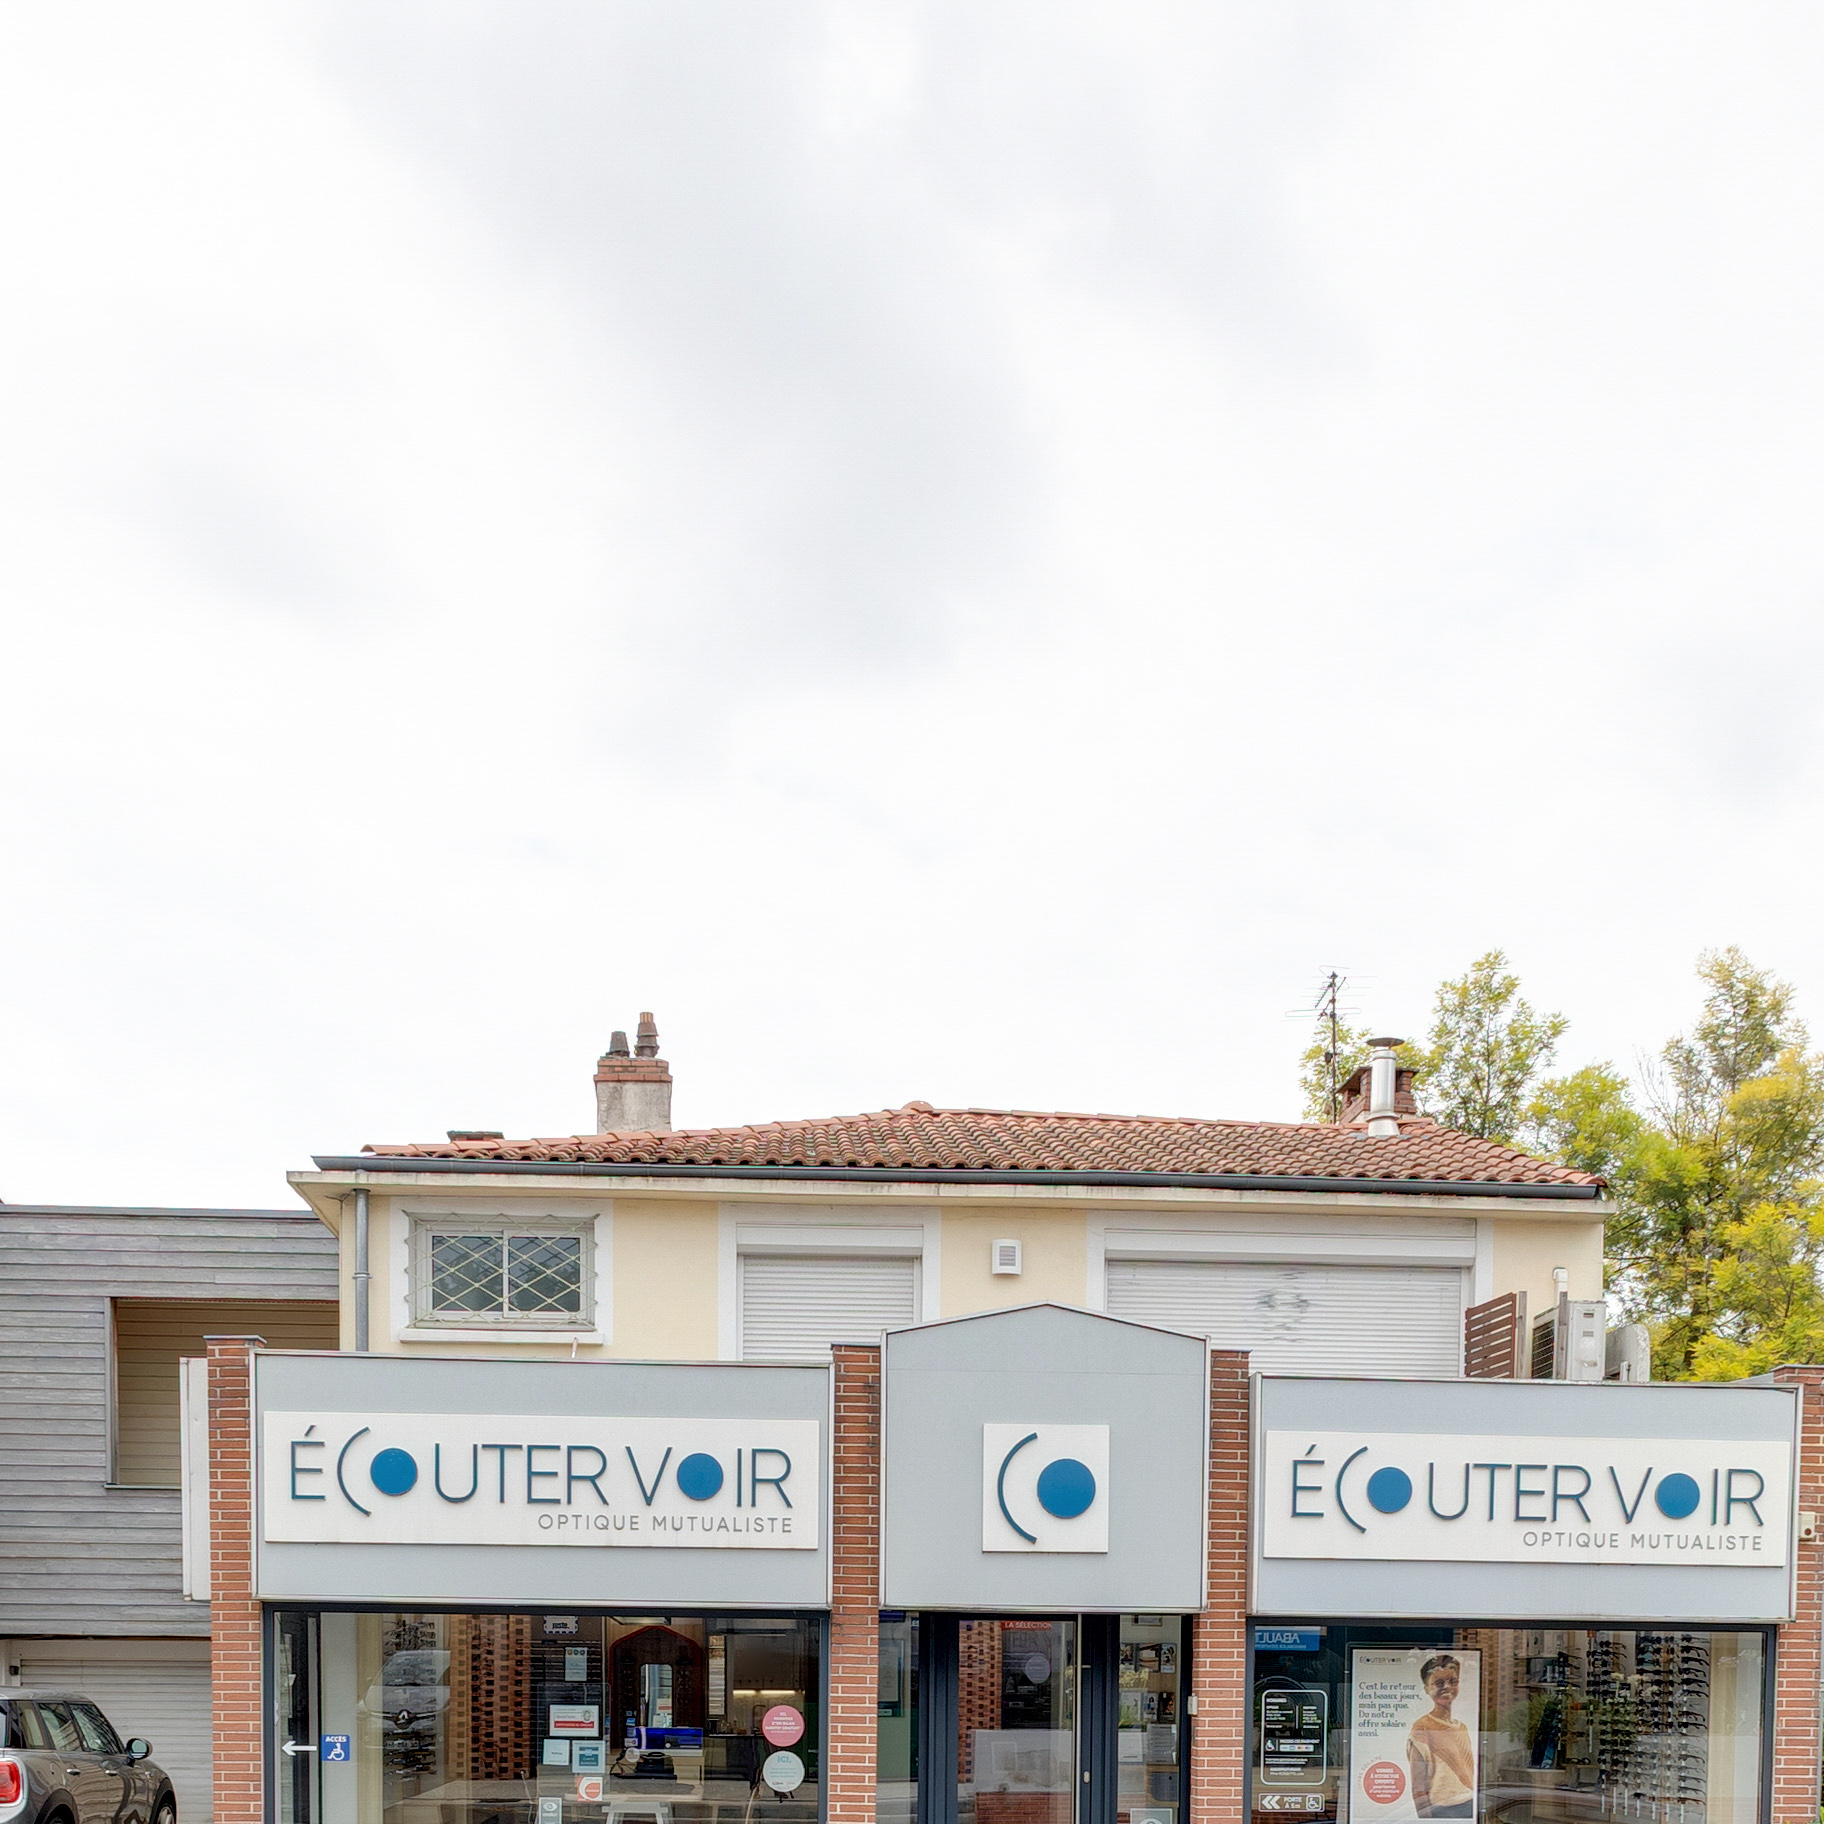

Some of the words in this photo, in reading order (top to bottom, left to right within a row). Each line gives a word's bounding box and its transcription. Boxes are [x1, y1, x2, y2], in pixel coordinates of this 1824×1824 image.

[625, 1444, 794, 1509] VOIR
[1609, 1465, 1765, 1526] VOIR
[538, 1513, 640, 1533] OPTIQUE
[652, 1515, 793, 1534] MUTUALISTE
[1522, 1531, 1619, 1549] OPTIQUE
[1630, 1533, 1763, 1552] MUTUALISTE
[1379, 1682, 1388, 1690] le
[1389, 1682, 1416, 1690] retour
[1358, 1691, 1372, 1700] des
[1371, 1710, 1395, 1718] notre
[1358, 1719, 1379, 1728] offre
[1380, 1720, 1406, 1728] solaire
